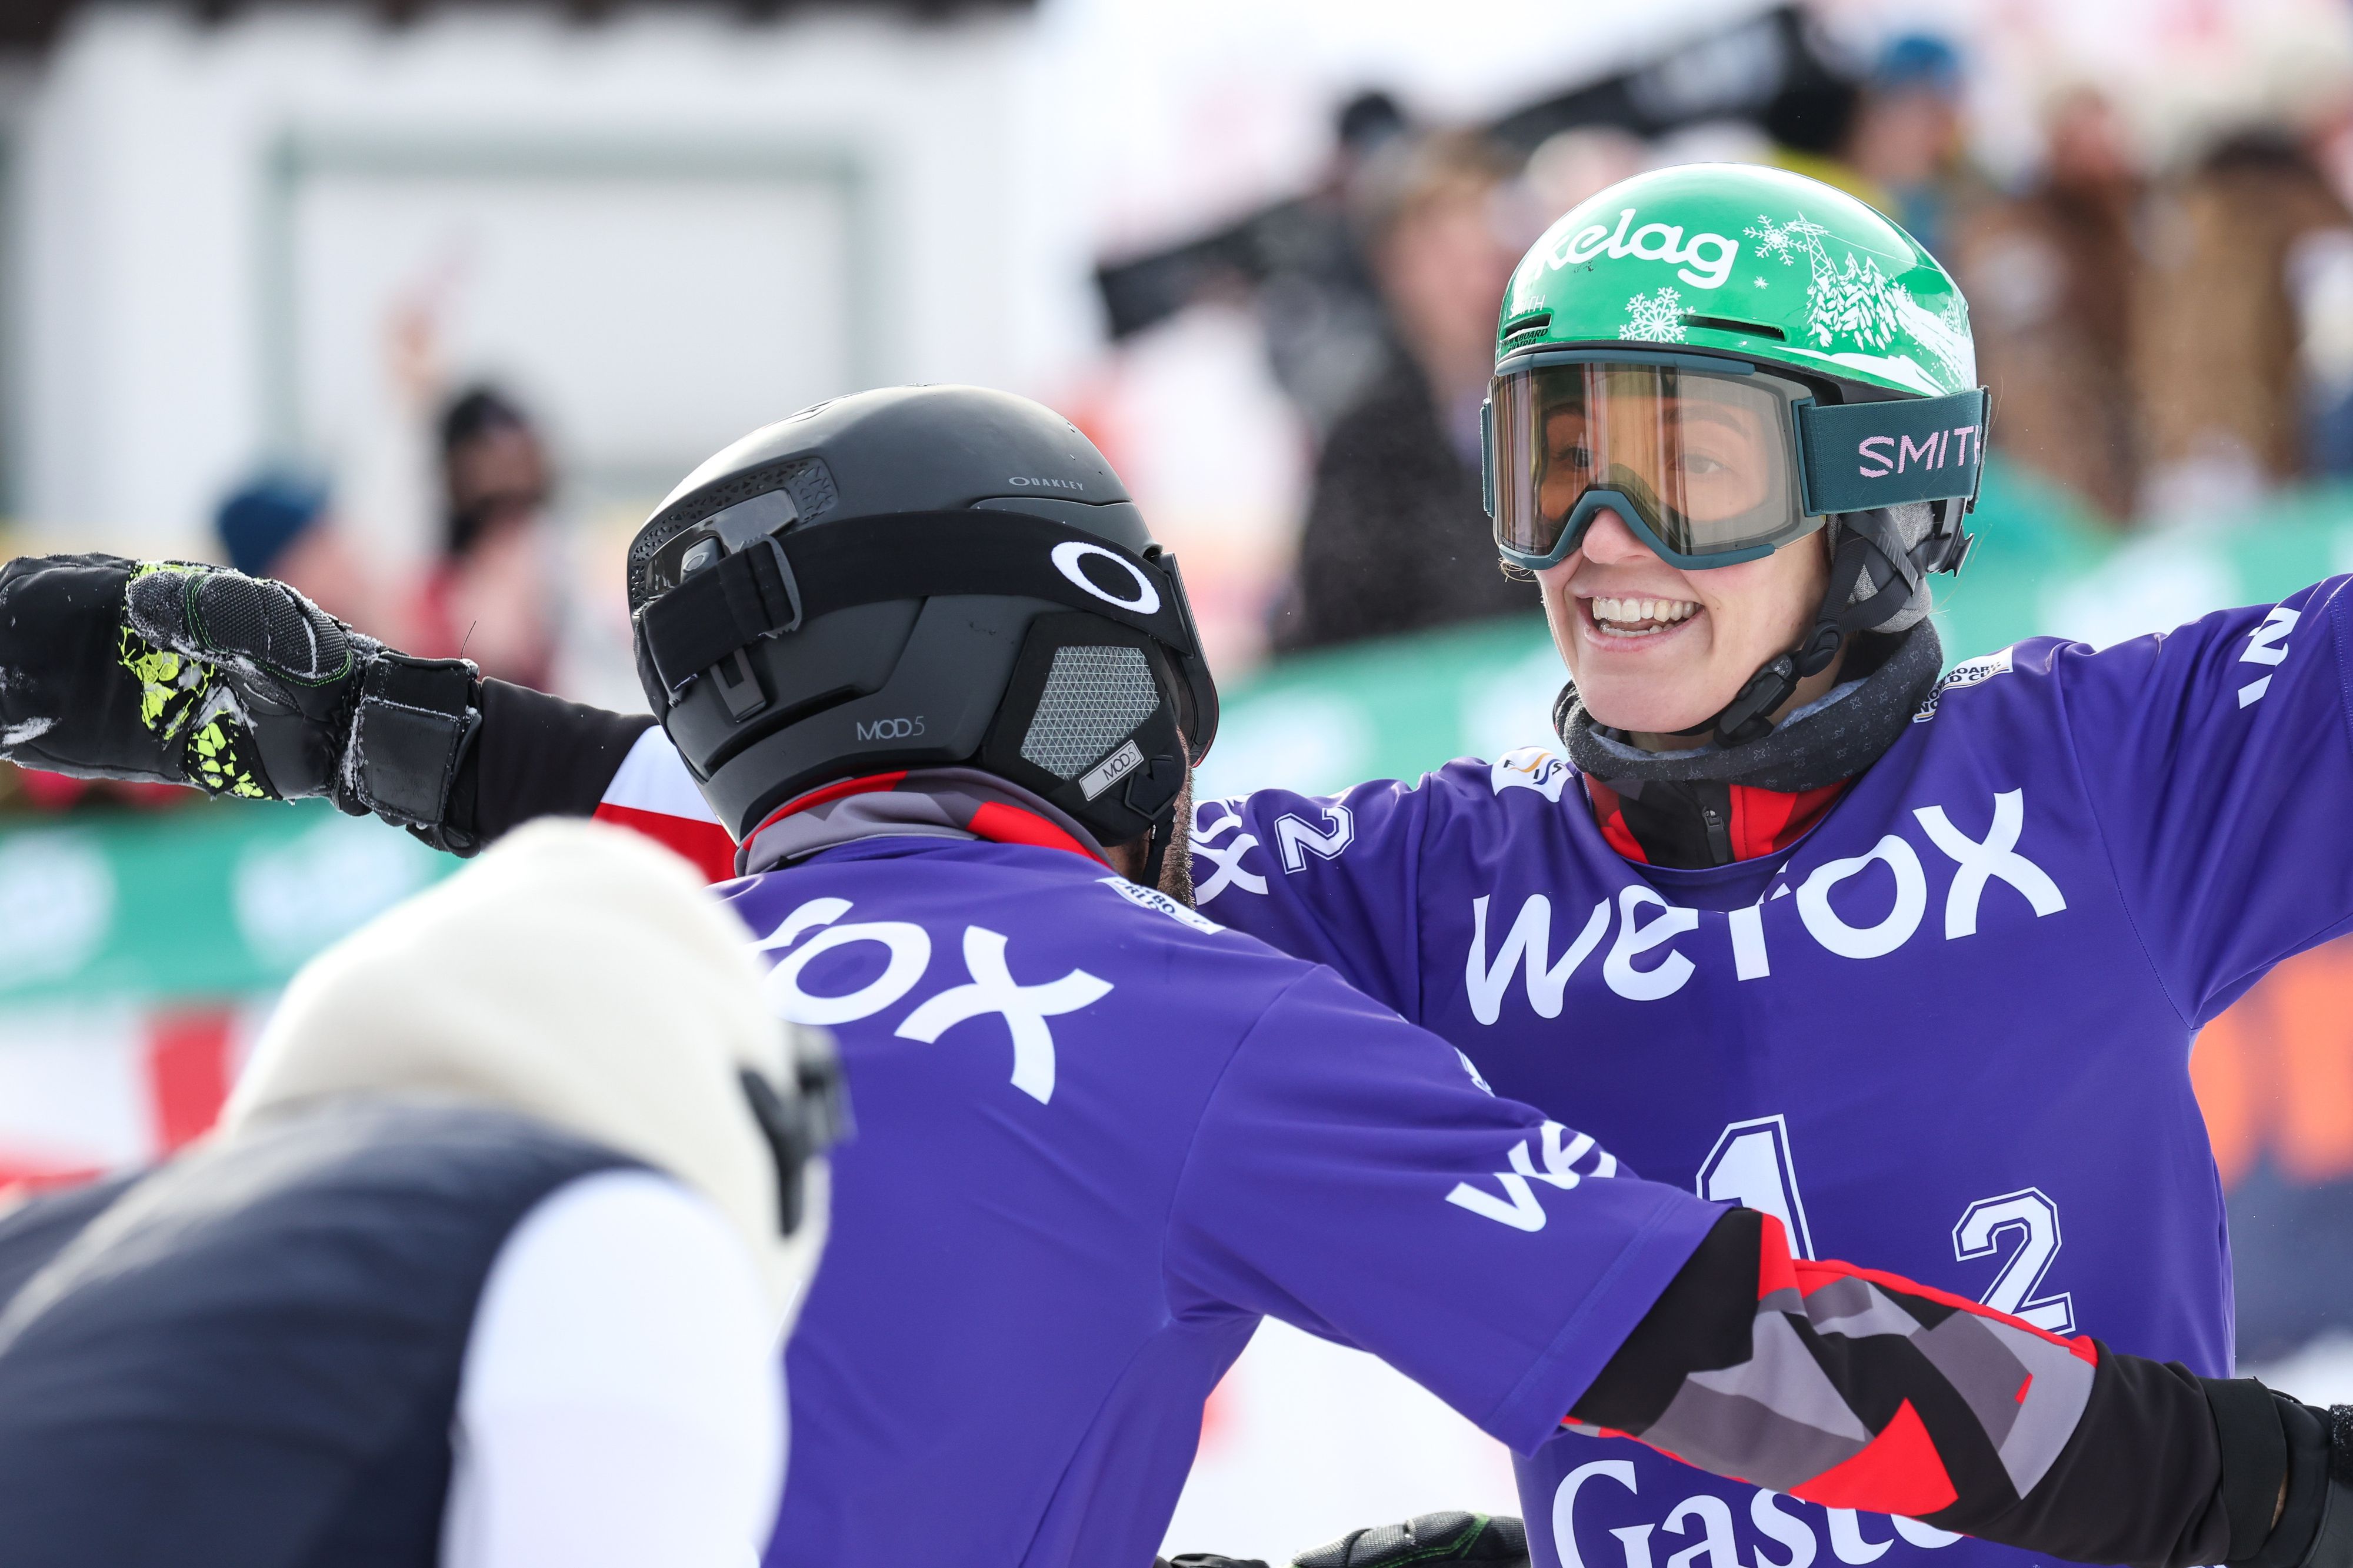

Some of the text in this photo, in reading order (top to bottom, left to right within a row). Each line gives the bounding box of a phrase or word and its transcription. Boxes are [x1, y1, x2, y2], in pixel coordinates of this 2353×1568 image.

[1533, 208, 1739, 289] kelag
[1031, 478, 1084, 491] OAKLEY
[1952, 1186, 2077, 1336] 2
